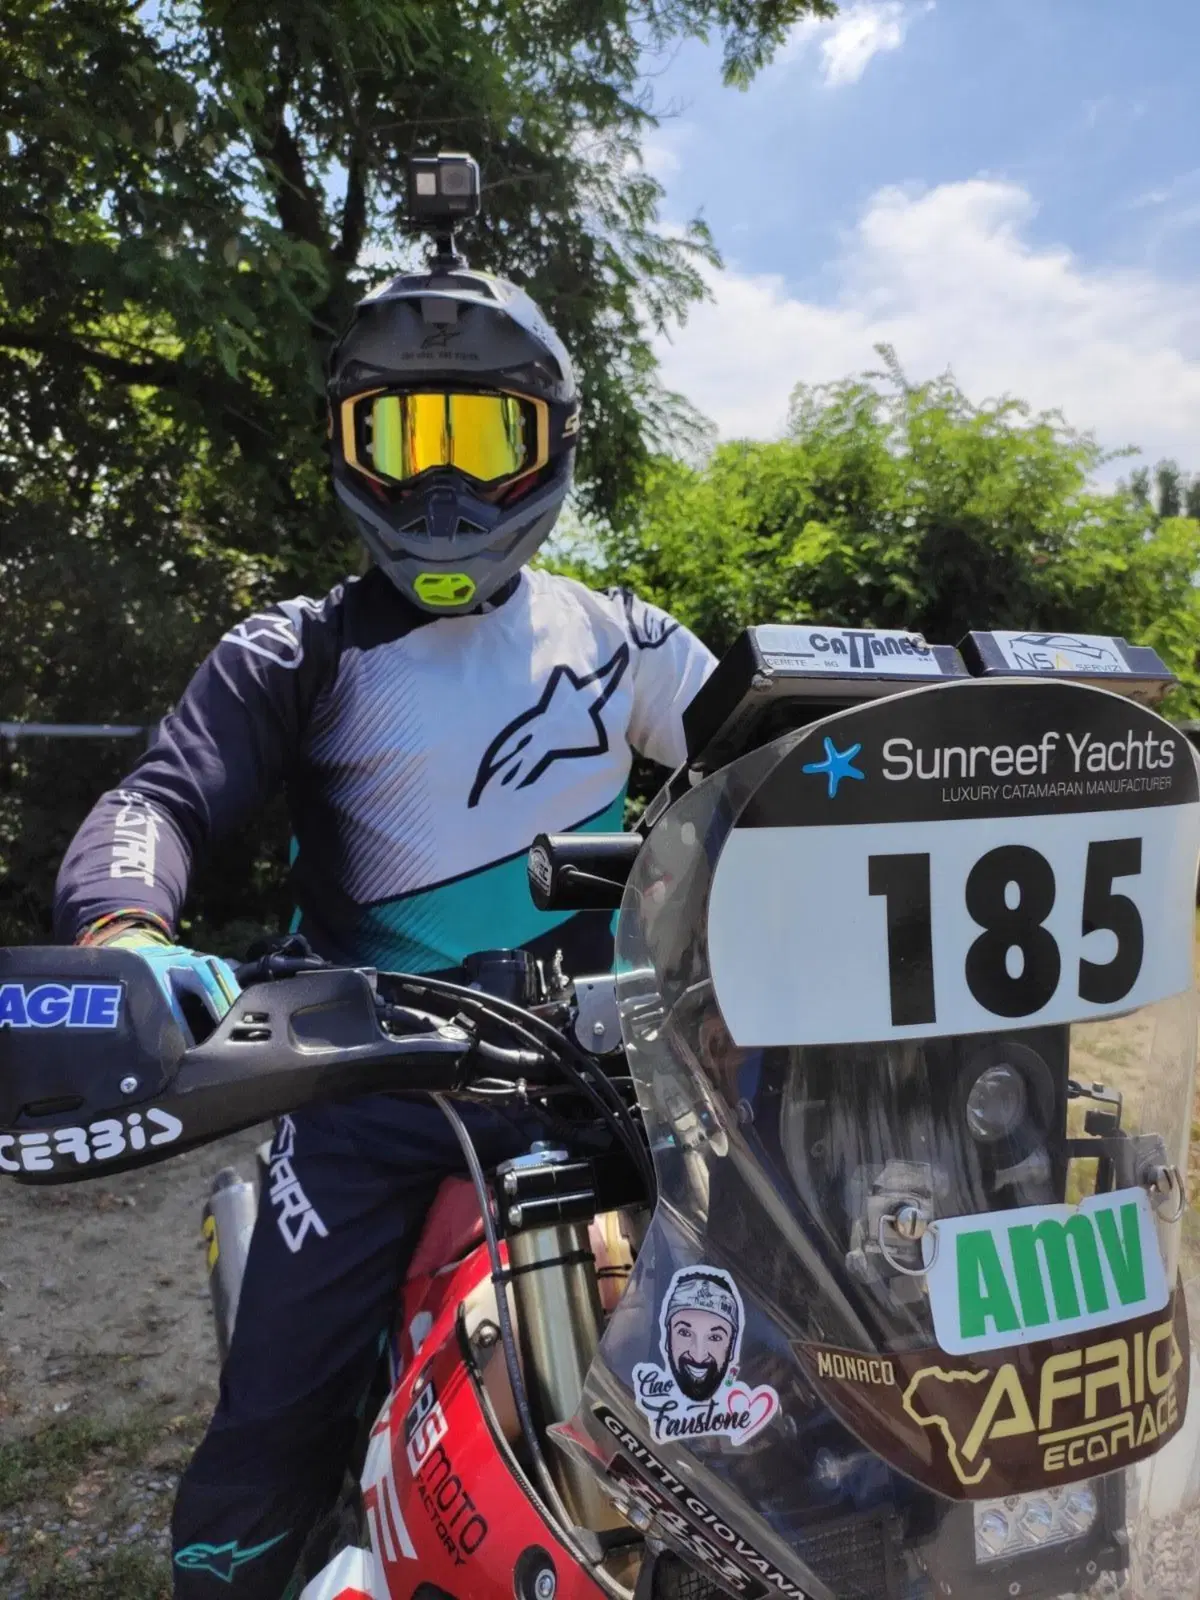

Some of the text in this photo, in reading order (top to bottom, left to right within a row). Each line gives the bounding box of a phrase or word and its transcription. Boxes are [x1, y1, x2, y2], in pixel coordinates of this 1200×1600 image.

[881, 729, 1176, 781] Sunreef Yachts
[942, 776, 1173, 803] LUXURY CATAMARAN MANUFACTURER
[868, 836, 1144, 1027] 185
[956, 1202, 1146, 1340] AMV
[638, 1370, 674, 1397] Ciao
[817, 1351, 895, 1387] MONACO
[641, 1398, 751, 1440] Faustone
[604, 1416, 684, 1494] GRITTI
